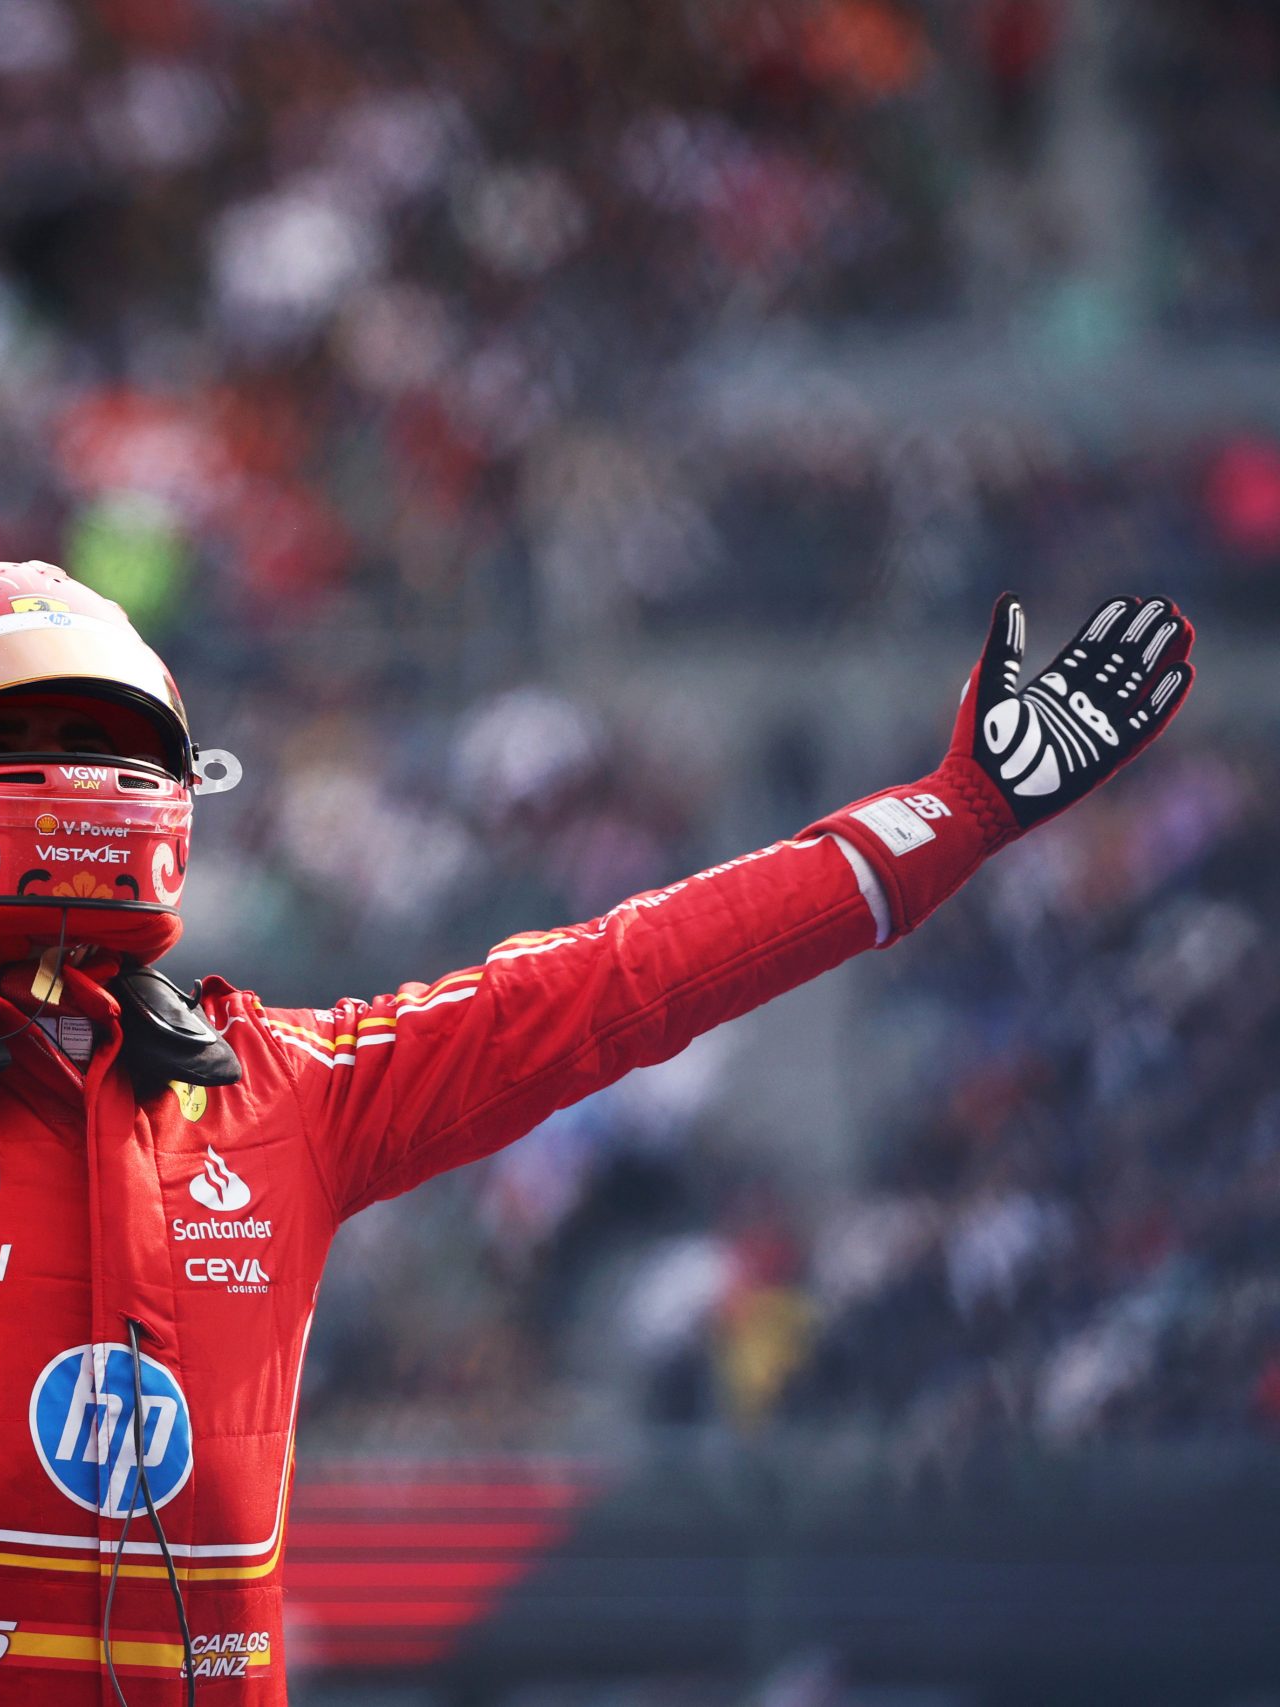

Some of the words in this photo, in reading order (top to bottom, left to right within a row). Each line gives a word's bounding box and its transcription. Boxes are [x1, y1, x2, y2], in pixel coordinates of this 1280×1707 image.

[59, 767, 108, 781] VGW
[73, 780, 100, 790] PLAY
[903, 793, 953, 819] 55
[63, 821, 130, 837] V-Power
[693, 843, 785, 880] MILLE
[173, 1216, 272, 1241] Santander
[227, 1285, 268, 1294] LOGISTIC
[55, 1350, 178, 1512] hp
[190, 1631, 269, 1655] CARLOS
